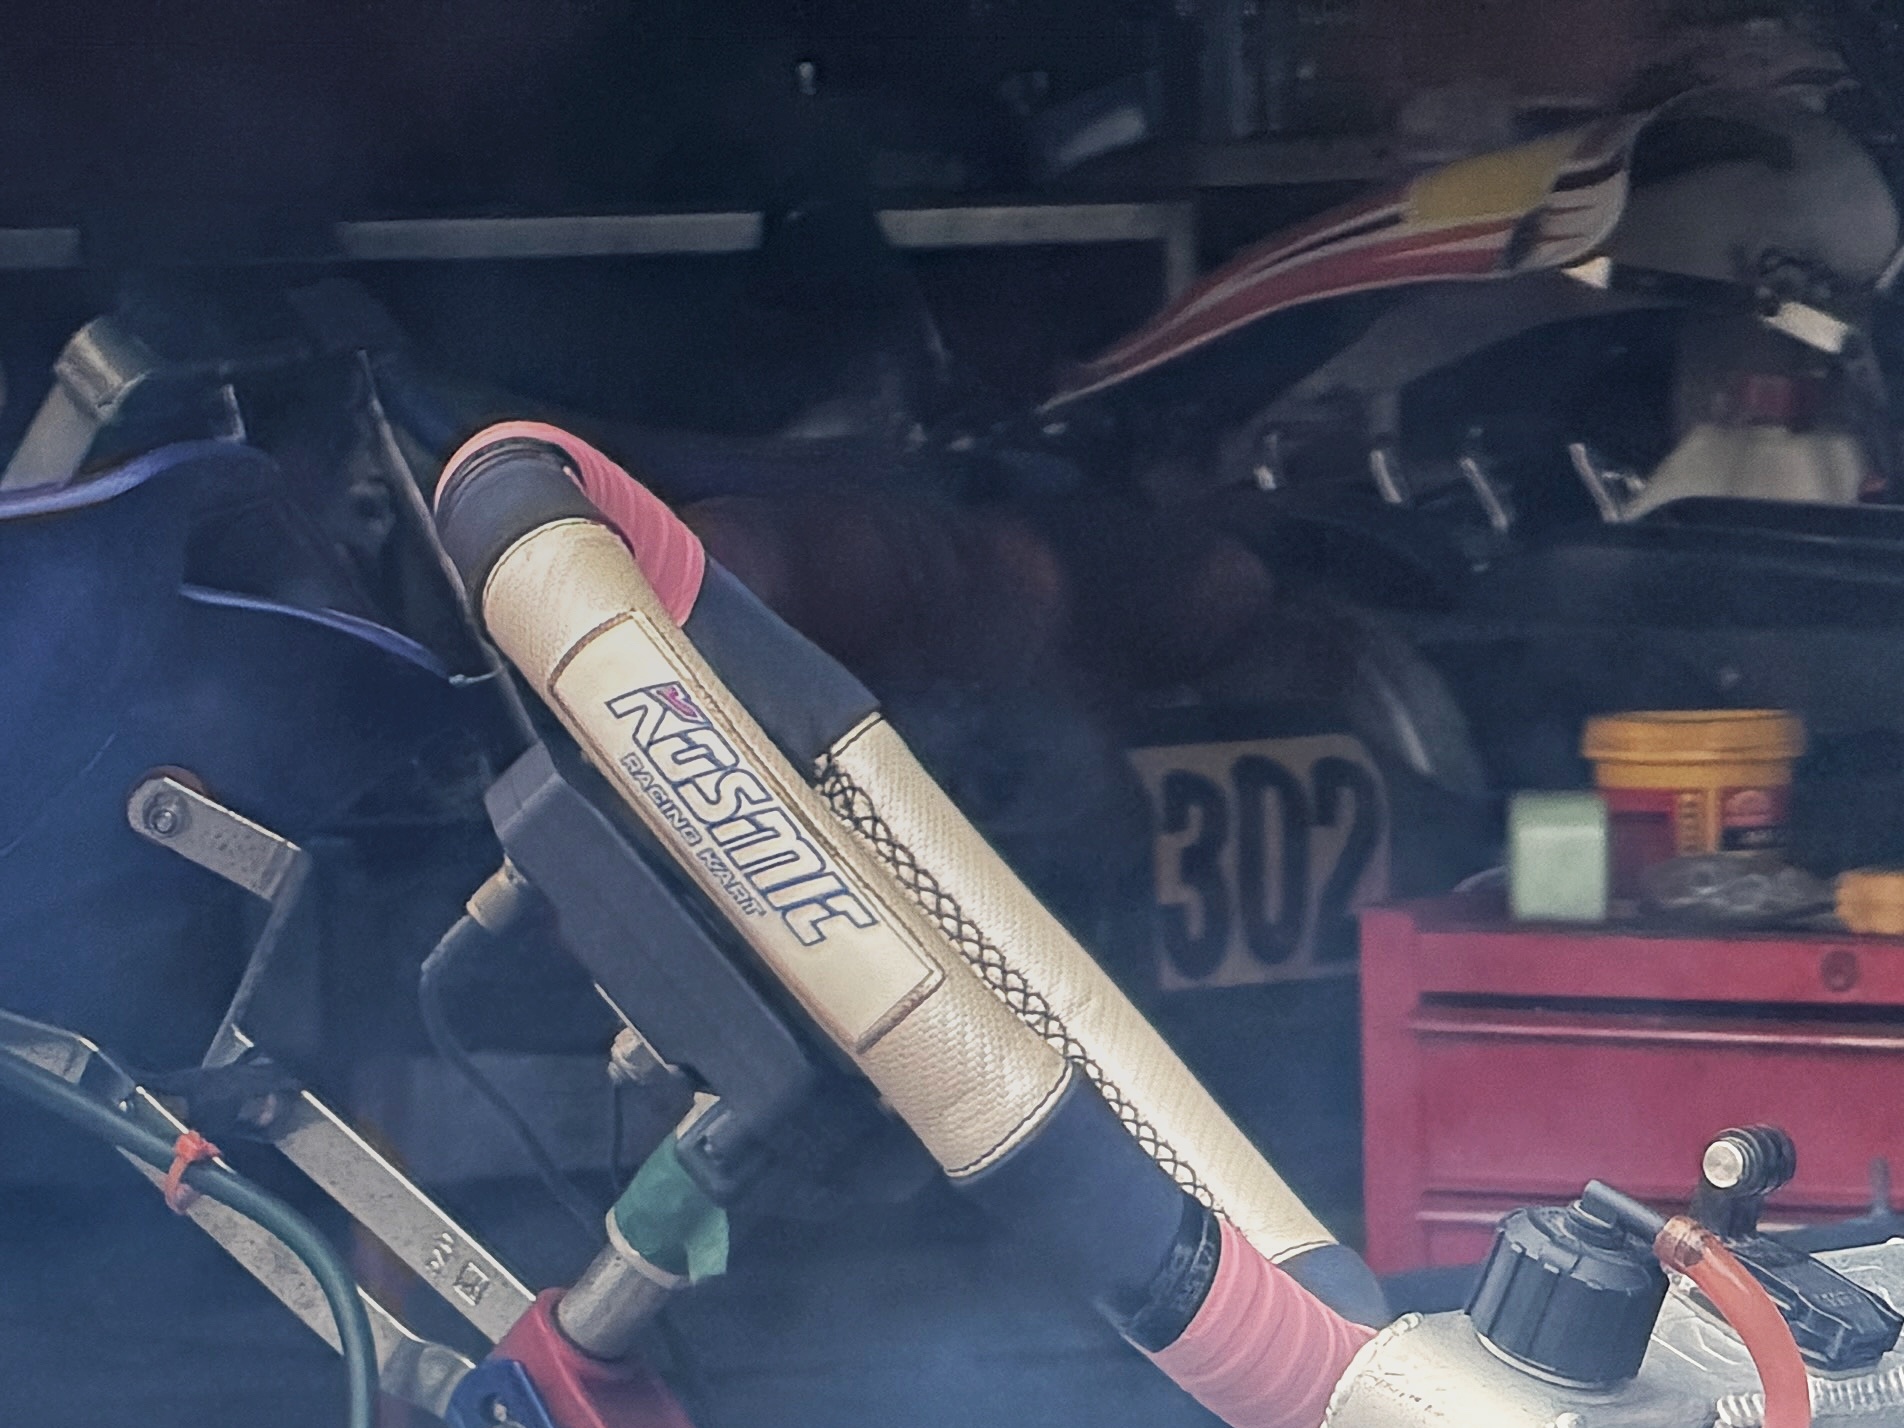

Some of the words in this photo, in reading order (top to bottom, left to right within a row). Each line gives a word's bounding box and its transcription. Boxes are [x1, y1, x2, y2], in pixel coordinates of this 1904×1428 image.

[621, 754, 702, 848] RACING
[697, 849, 766, 918] KART
[1157, 755, 1379, 979] 302
